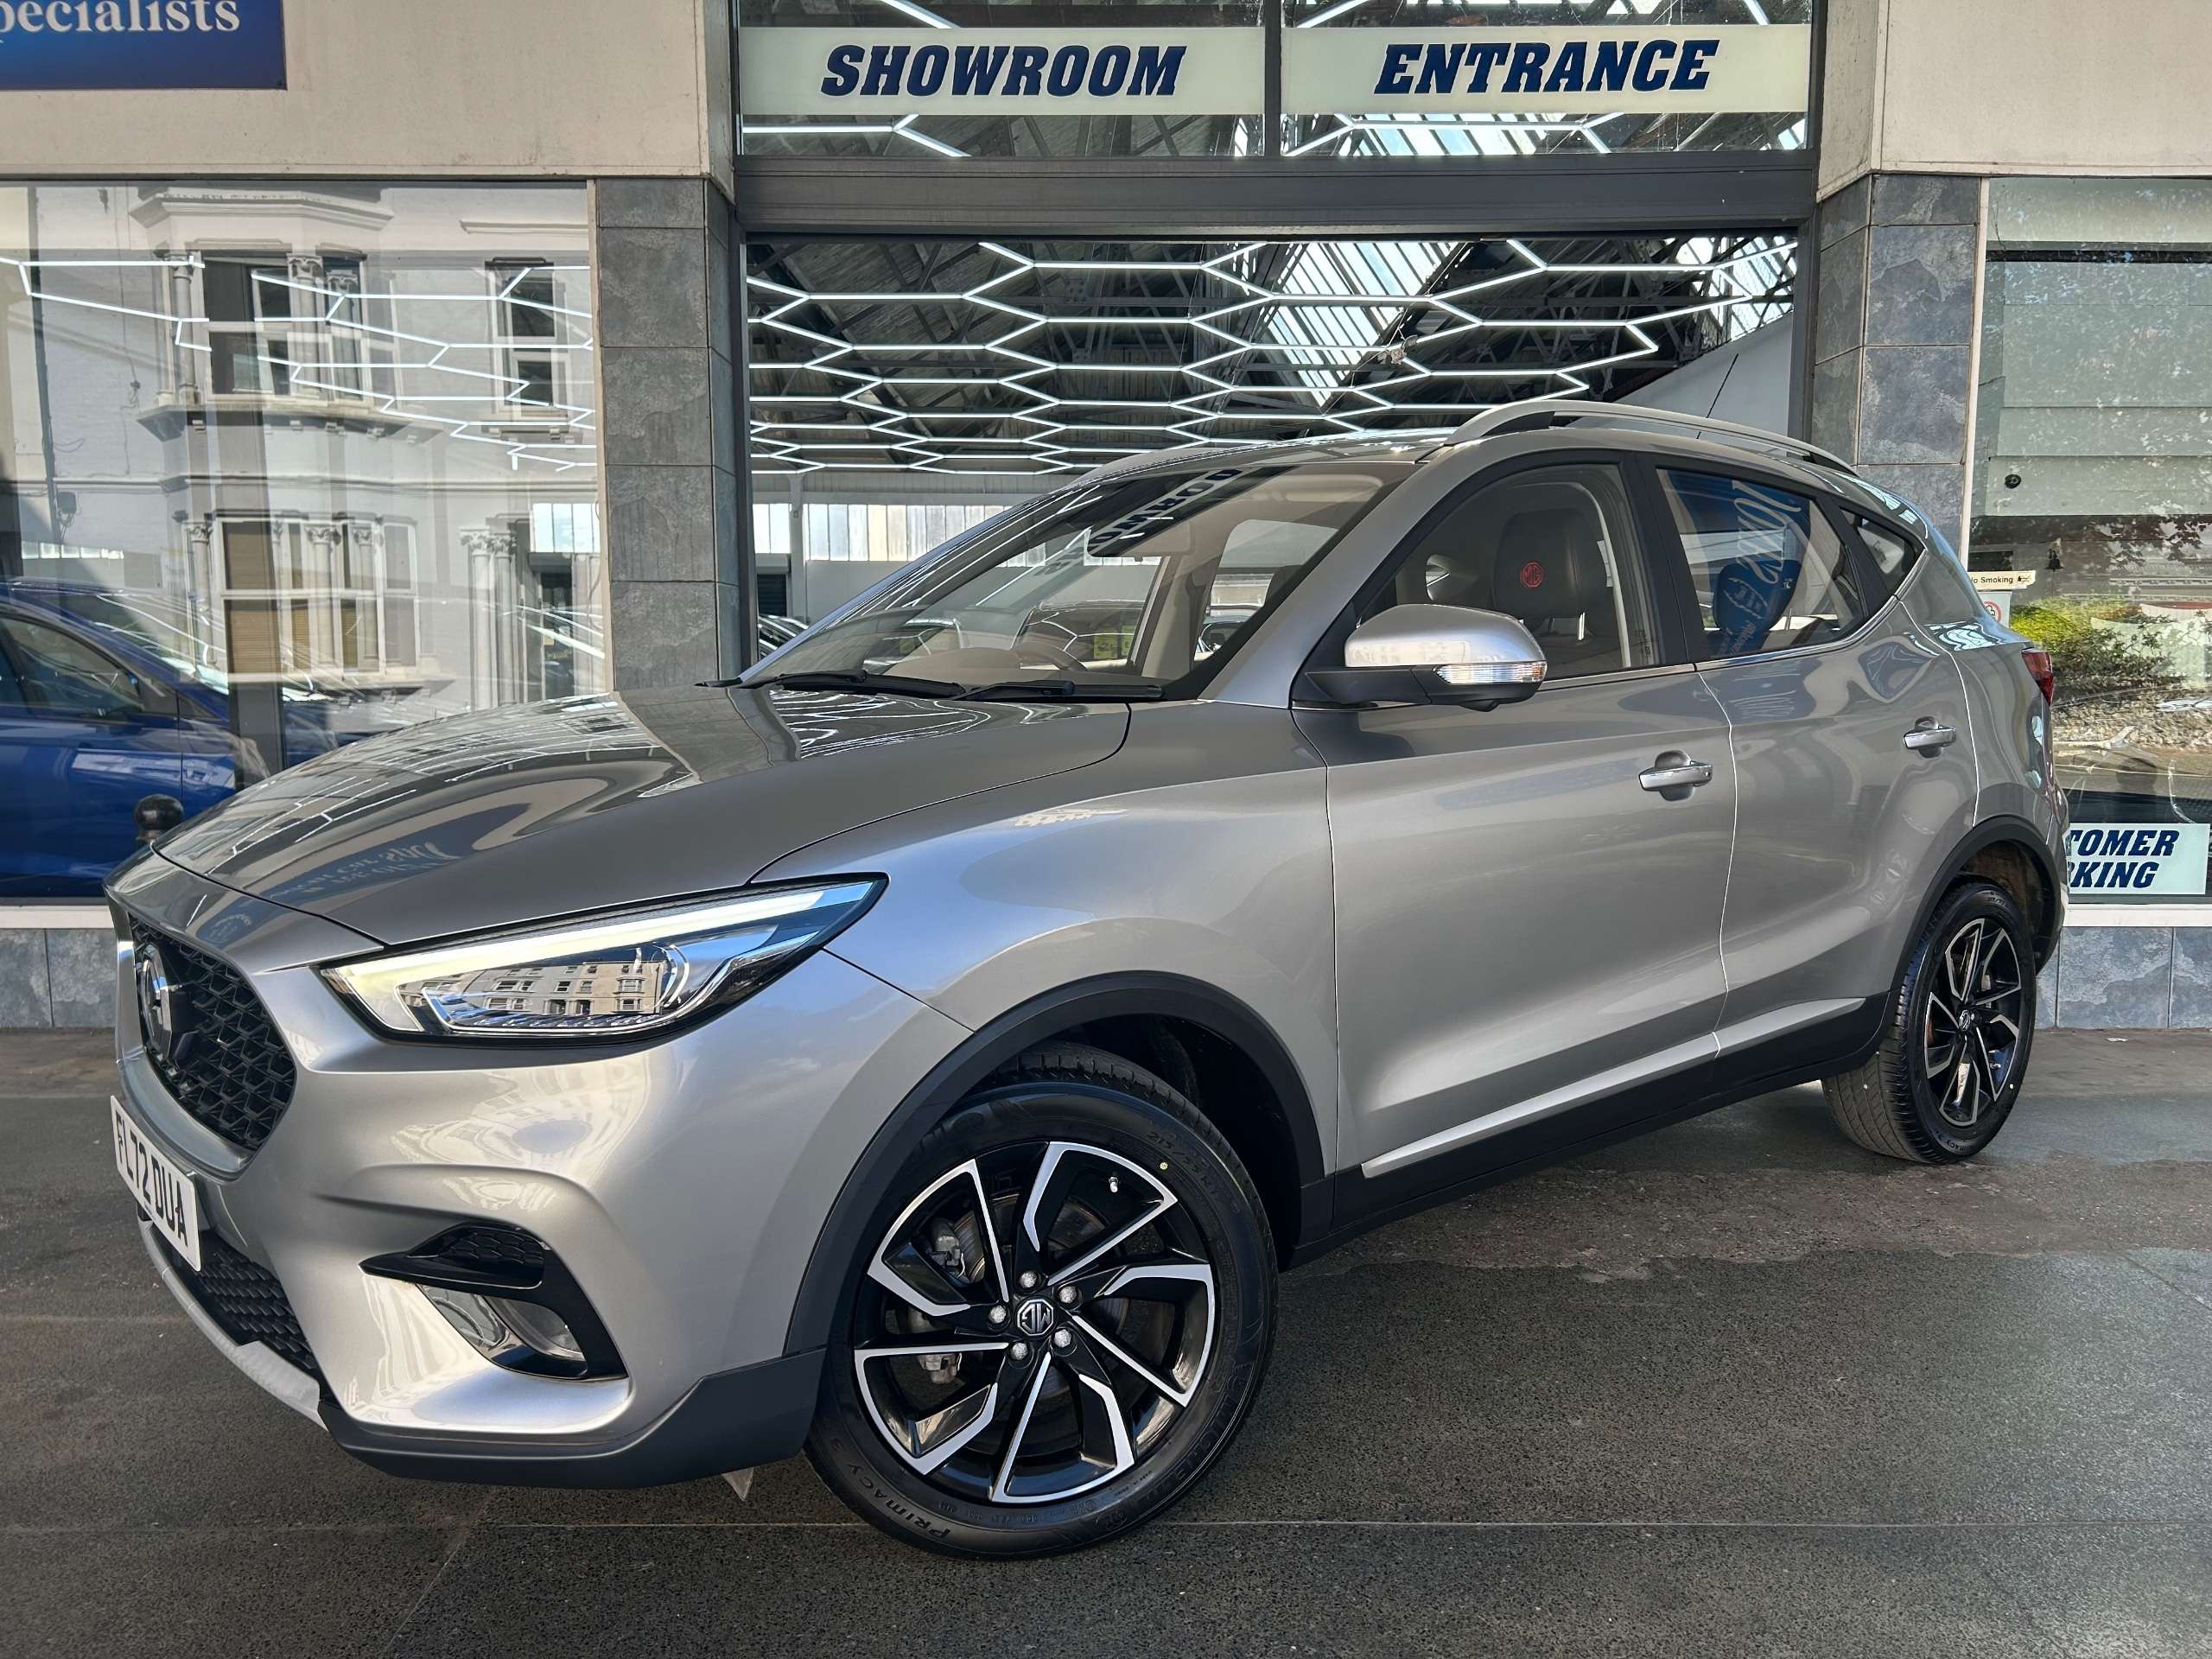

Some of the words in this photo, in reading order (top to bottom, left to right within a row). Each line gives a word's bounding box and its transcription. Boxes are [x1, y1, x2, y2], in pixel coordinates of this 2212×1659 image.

[820, 44, 1187, 97] SHOWROOM
[1373, 39, 1719, 94] ENTRANCE
[1980, 575, 2013, 584] Smoking
[844, 1464, 950, 1538] PRIMACY
